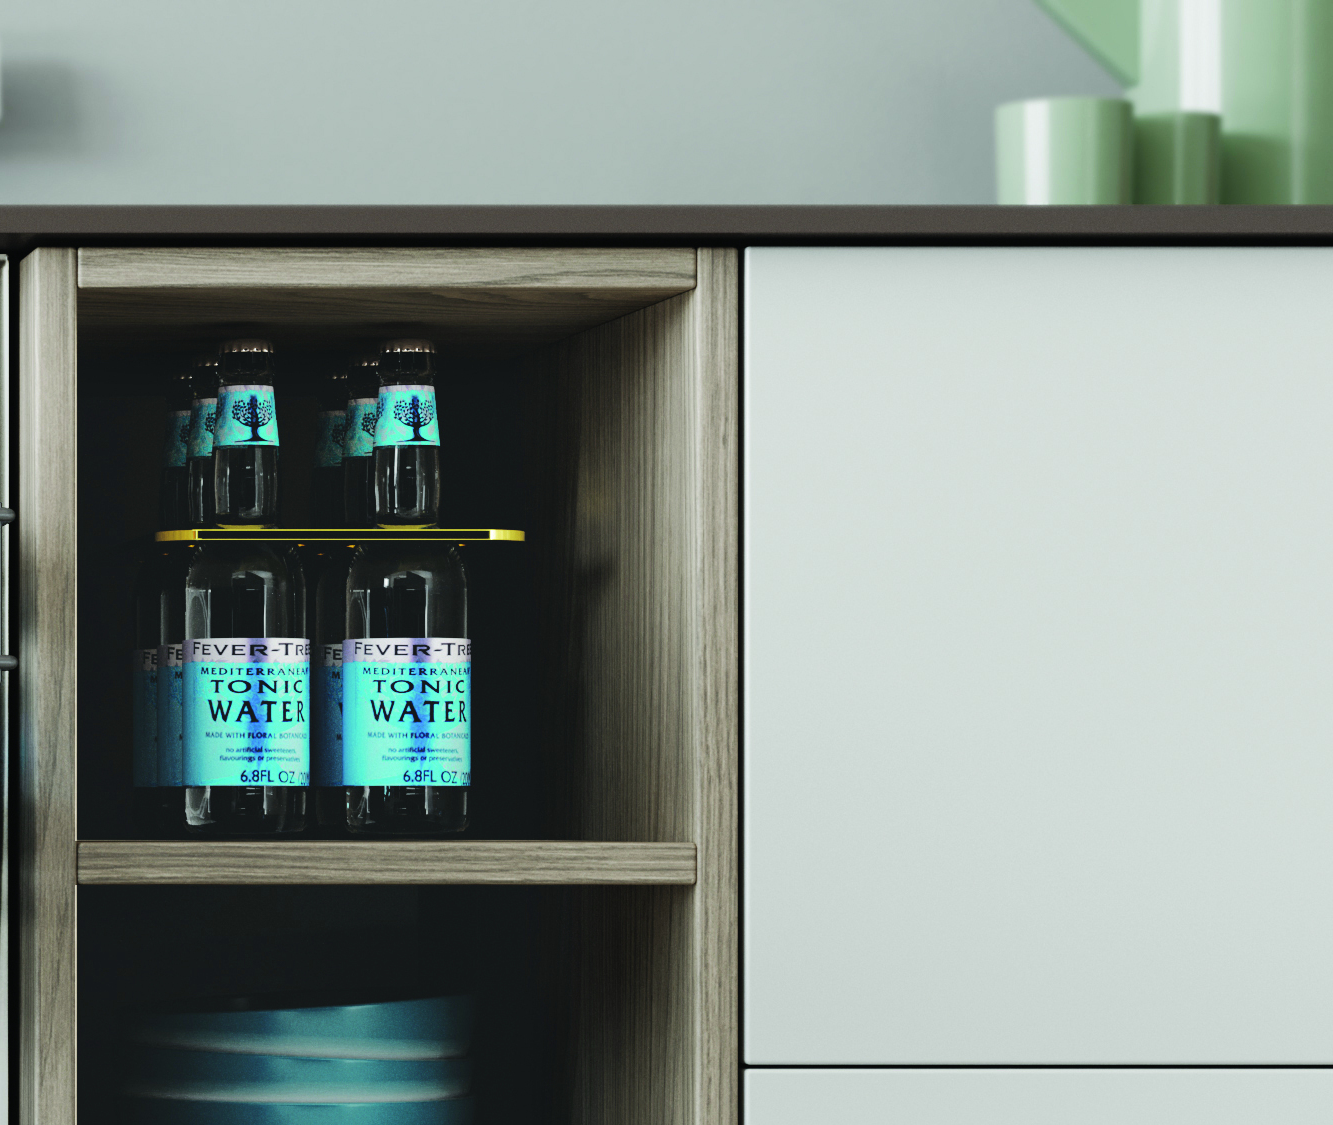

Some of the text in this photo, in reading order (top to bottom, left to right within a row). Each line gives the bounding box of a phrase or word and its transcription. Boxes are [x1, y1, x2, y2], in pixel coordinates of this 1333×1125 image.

[193, 641, 310, 656] FEVER-TRE
[354, 641, 471, 656] FEVER-TRE
[211, 680, 303, 693] TONIC
[373, 680, 465, 693] TONIC
[208, 699, 305, 722] WATER
[370, 699, 467, 722] WATER
[205, 731, 223, 739] MADE
[247, 731, 277, 739] FLORAL
[367, 731, 385, 739] MADE
[410, 731, 440, 739] FLORAL
[240, 770, 275, 783] 6.8FL
[278, 770, 295, 783] OZ
[403, 770, 438, 783] 6.8FL
[441, 770, 458, 783] OZ
